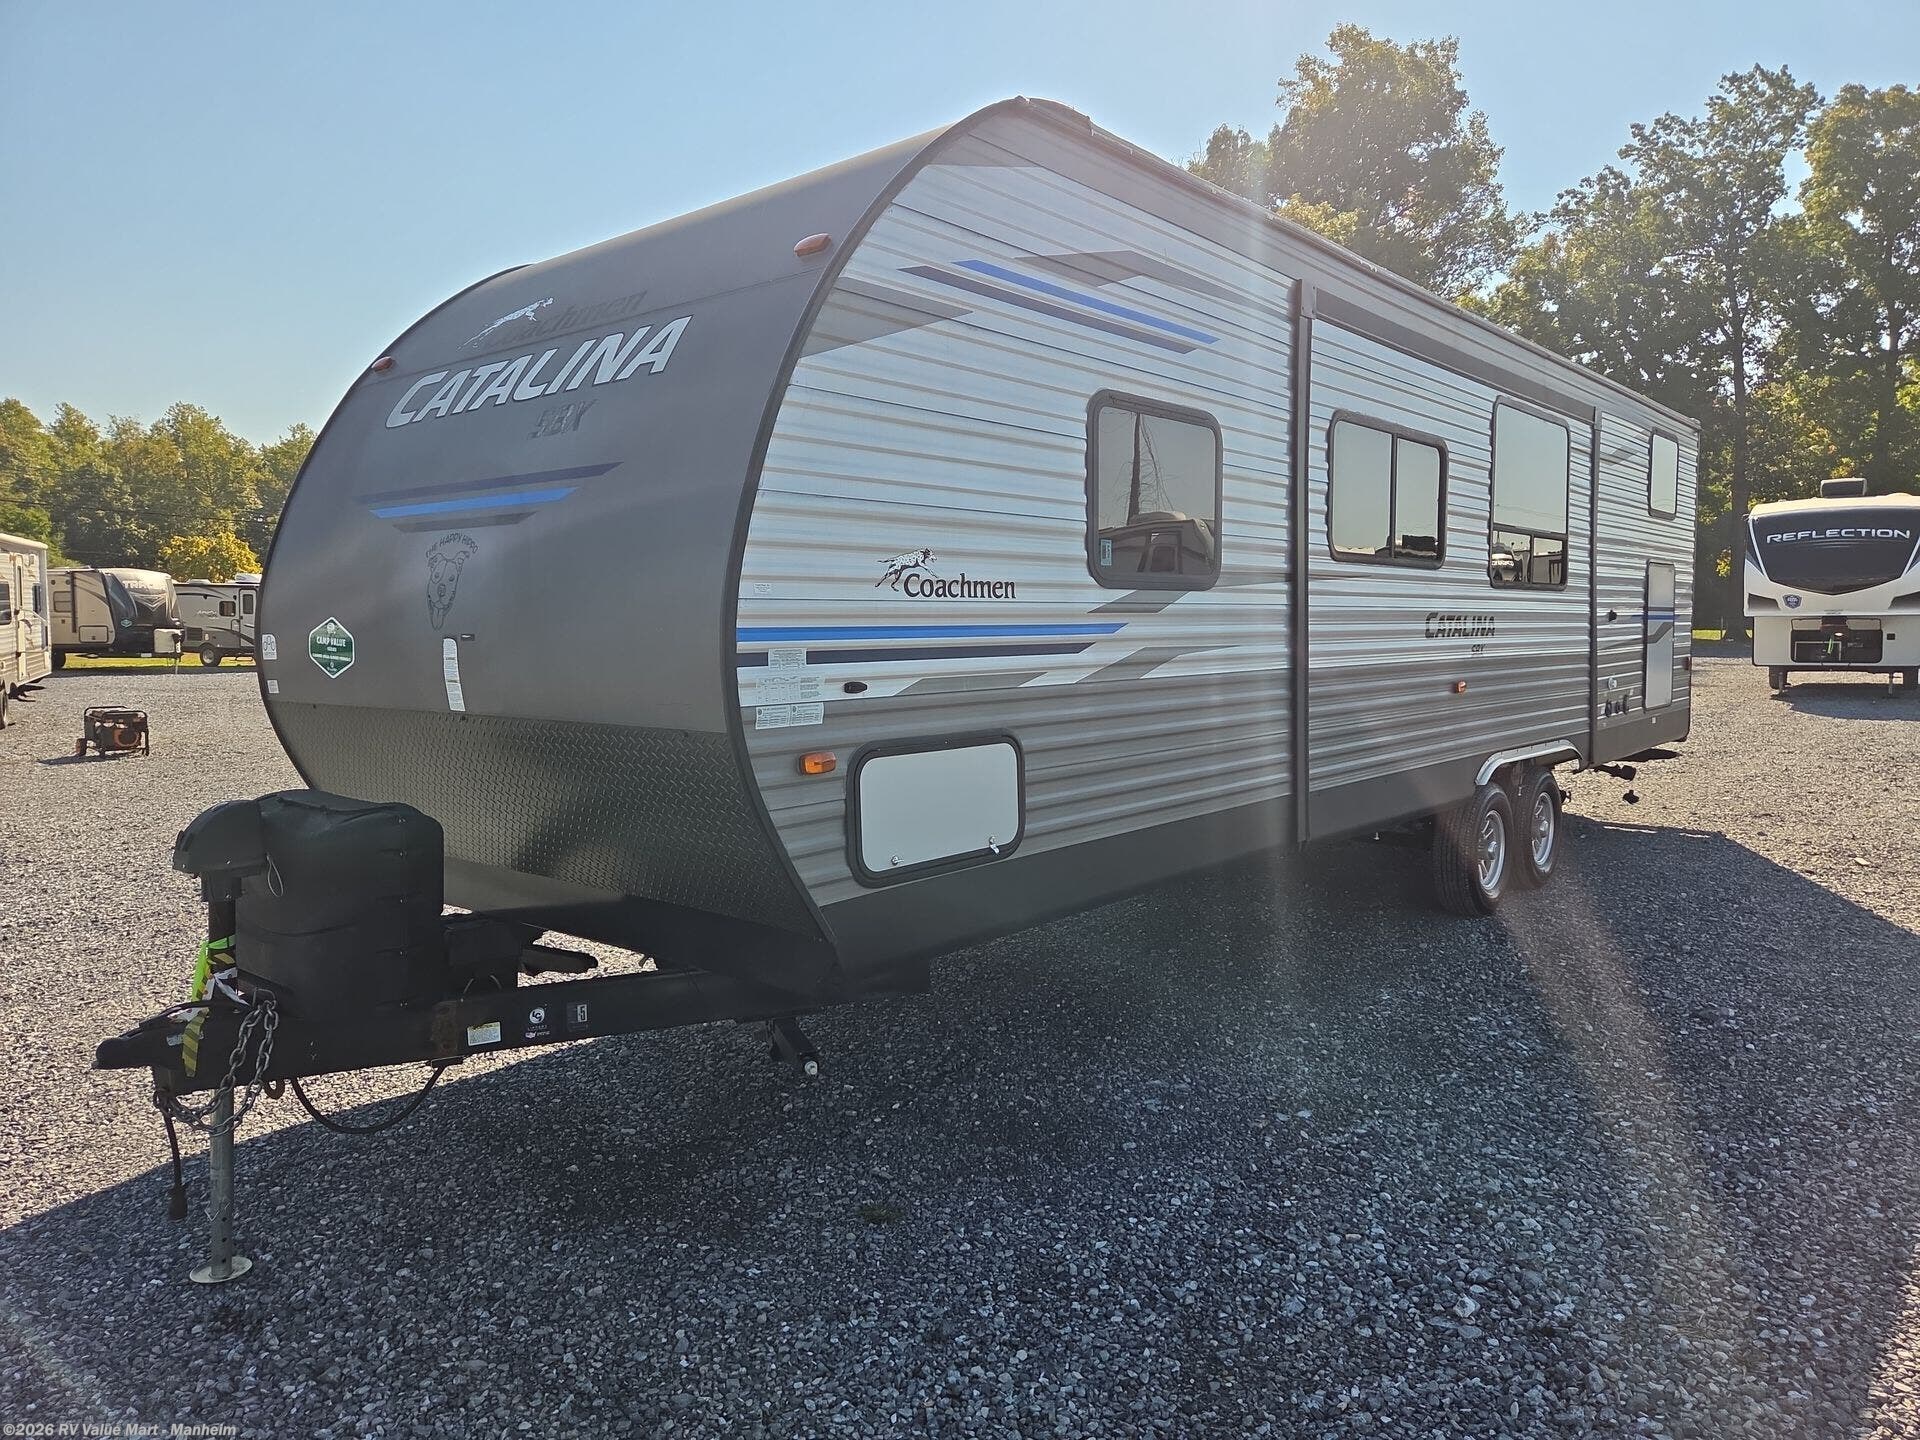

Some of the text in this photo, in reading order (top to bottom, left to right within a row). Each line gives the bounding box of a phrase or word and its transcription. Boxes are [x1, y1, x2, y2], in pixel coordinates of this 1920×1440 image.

[385, 315, 694, 429] CATALINA
[1766, 528, 1911, 544] REFLECTION
[903, 573, 1017, 599] Coachmen
[1424, 612, 1496, 639] CATALINA
